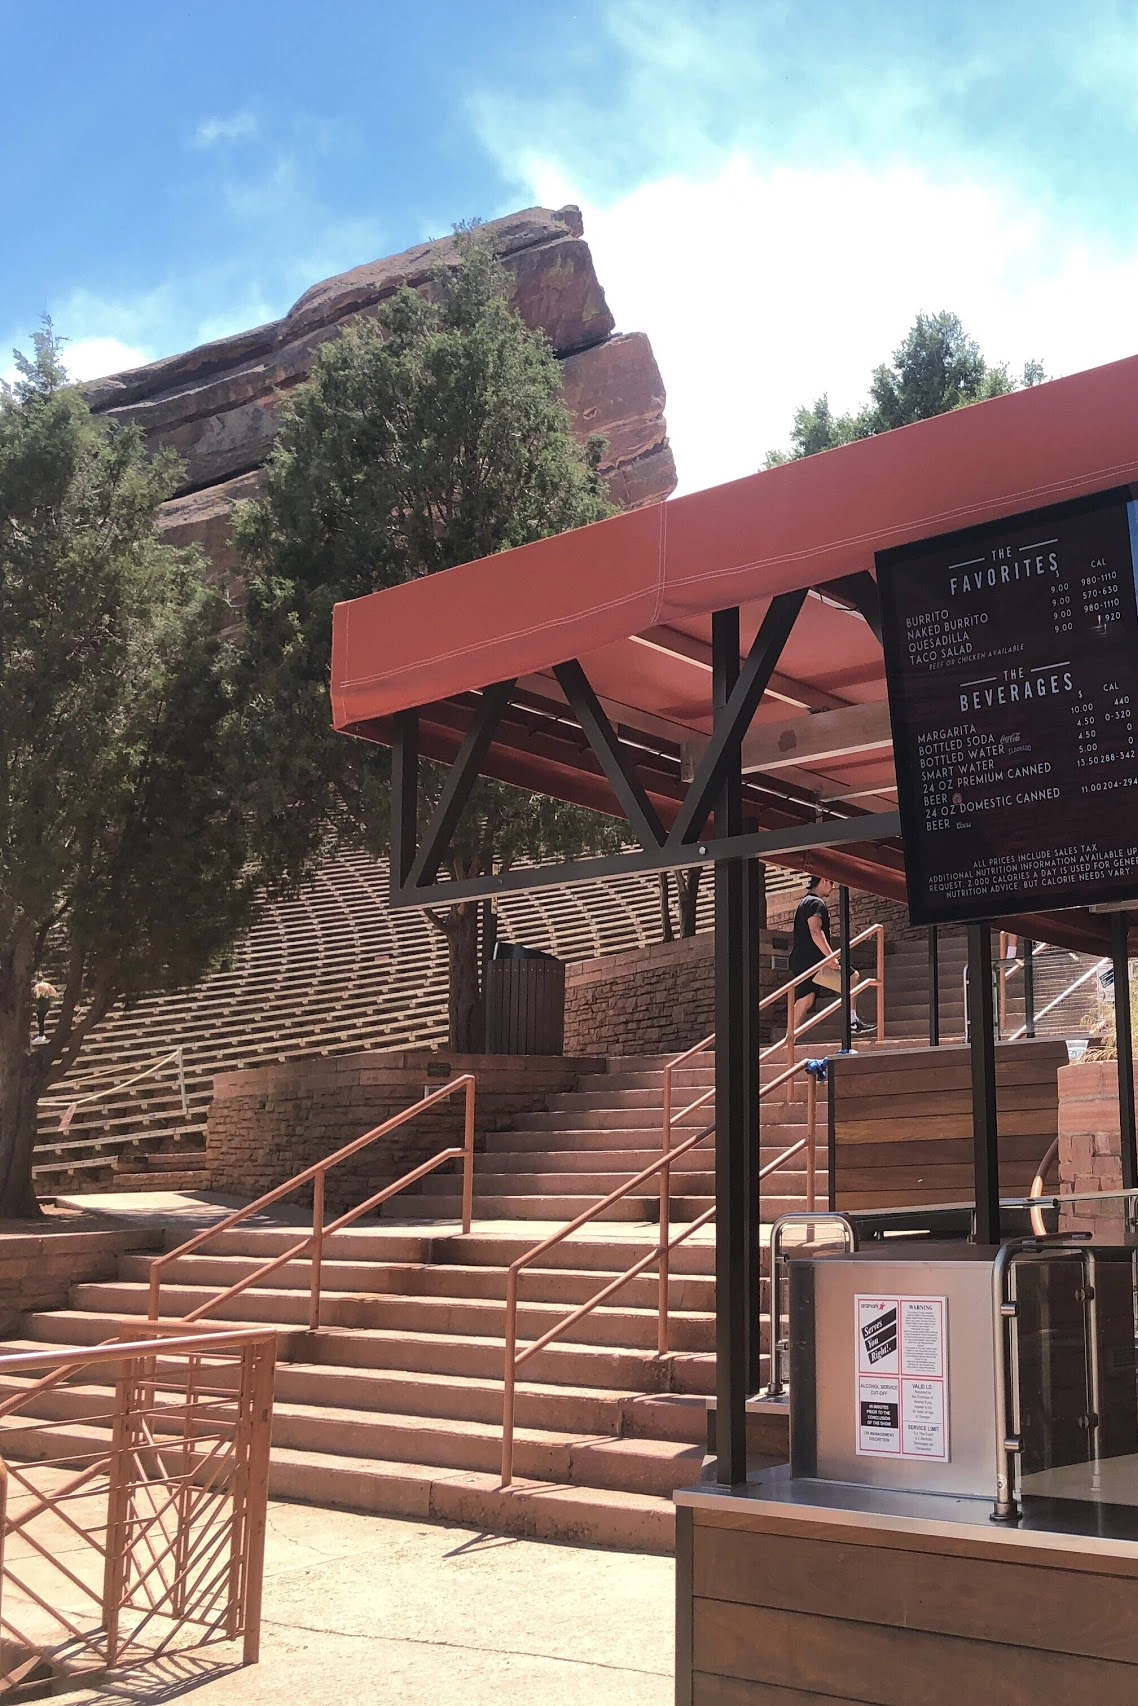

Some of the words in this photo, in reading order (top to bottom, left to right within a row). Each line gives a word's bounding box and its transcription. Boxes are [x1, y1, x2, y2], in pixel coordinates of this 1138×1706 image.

[992, 547, 1012, 561] THE
[1091, 558, 1106, 568] CAL
[950, 553, 1058, 595] FAVORITES
[906, 610, 949, 627] BURRITO
[1051, 583, 1069, 593] 9.00
[1081, 571, 1117, 586] 980-1110
[907, 624, 941, 640] NAKED
[944, 613, 988, 632] BURRITO
[1052, 596, 1070, 607] 9.00
[1082, 584, 1118, 599] 570-630
[909, 632, 969, 652] QUESADILLA
[1053, 610, 1072, 620] 9.00
[1084, 598, 1119, 613] 980-1110
[910, 652, 937, 665] TACO
[941, 643, 973, 659] SALAD
[1055, 623, 1073, 633] 9.00
[1105, 612, 1120, 621] 920
[929, 661, 944, 670] BEEF
[957, 652, 985, 664] CHICKEN
[988, 644, 1024, 658] AVAILABLE
[1003, 667, 1024, 681] THE
[960, 673, 1073, 712] BEVERAGES
[1103, 682, 1119, 692] CAL
[917, 724, 976, 744] MARGARITA
[1071, 703, 1093, 714] 10.00
[1114, 696, 1129, 706] 440
[919, 741, 963, 756] BOTTLED
[967, 734, 994, 747] SODA
[1077, 717, 1094, 727] 4.50
[1105, 710, 1131, 722] 0-320
[920, 754, 964, 769] BOTTLED
[969, 745, 1004, 759] WATER
[1078, 730, 1096, 740] 4.50
[1127, 723, 1132, 731] 0
[922, 768, 953, 781] SMART
[959, 760, 994, 773] WATER
[1079, 743, 1097, 753] 5.00
[1128, 736, 1133, 744] 0
[923, 784, 934, 794] 24
[939, 781, 953, 790] OZ
[957, 770, 1003, 787] PREMIUM
[1008, 763, 1051, 779] CANNED
[1077, 757, 1099, 767] 13.50
[1100, 750, 1135, 763] 288-342
[924, 795, 947, 806] BEER
[925, 809, 936, 819] 24
[941, 806, 955, 815] OZ
[960, 797, 1012, 814] DOMESTIC
[1016, 788, 1060, 804] CANNED
[1081, 783, 1101, 793] 11.00
[1102, 778, 1138, 790] 204-294
[926, 820, 950, 831] BEER
[929, 871, 973, 883] ADDITIONAL
[976, 864, 1018, 877] NUTRITION
[1021, 857, 1076, 871] INFORMATION
[1080, 849, 1124, 862] AVAILABLE
[989, 856, 1015, 866] PRICES
[1018, 851, 1051, 862] INCLUDE
[1055, 847, 1078, 857] SALES
[1081, 844, 1097, 853] TAX
[930, 881, 964, 892] REQUEST.
[993, 872, 1030, 884] CALORIES
[1041, 868, 1056, 877] DAY
[1070, 863, 1091, 873] USED
[1094, 860, 1110, 869] FOR
[947, 886, 987, 898] NUTRITION
[1024, 880, 1038, 888] BUT
[1042, 875, 1075, 886] CALORIE
[1079, 871, 1105, 881] NEEDS
[1108, 868, 1134, 877] VARY.
[864, 1321, 882, 1337] Serves
[867, 1338, 879, 1348] You
